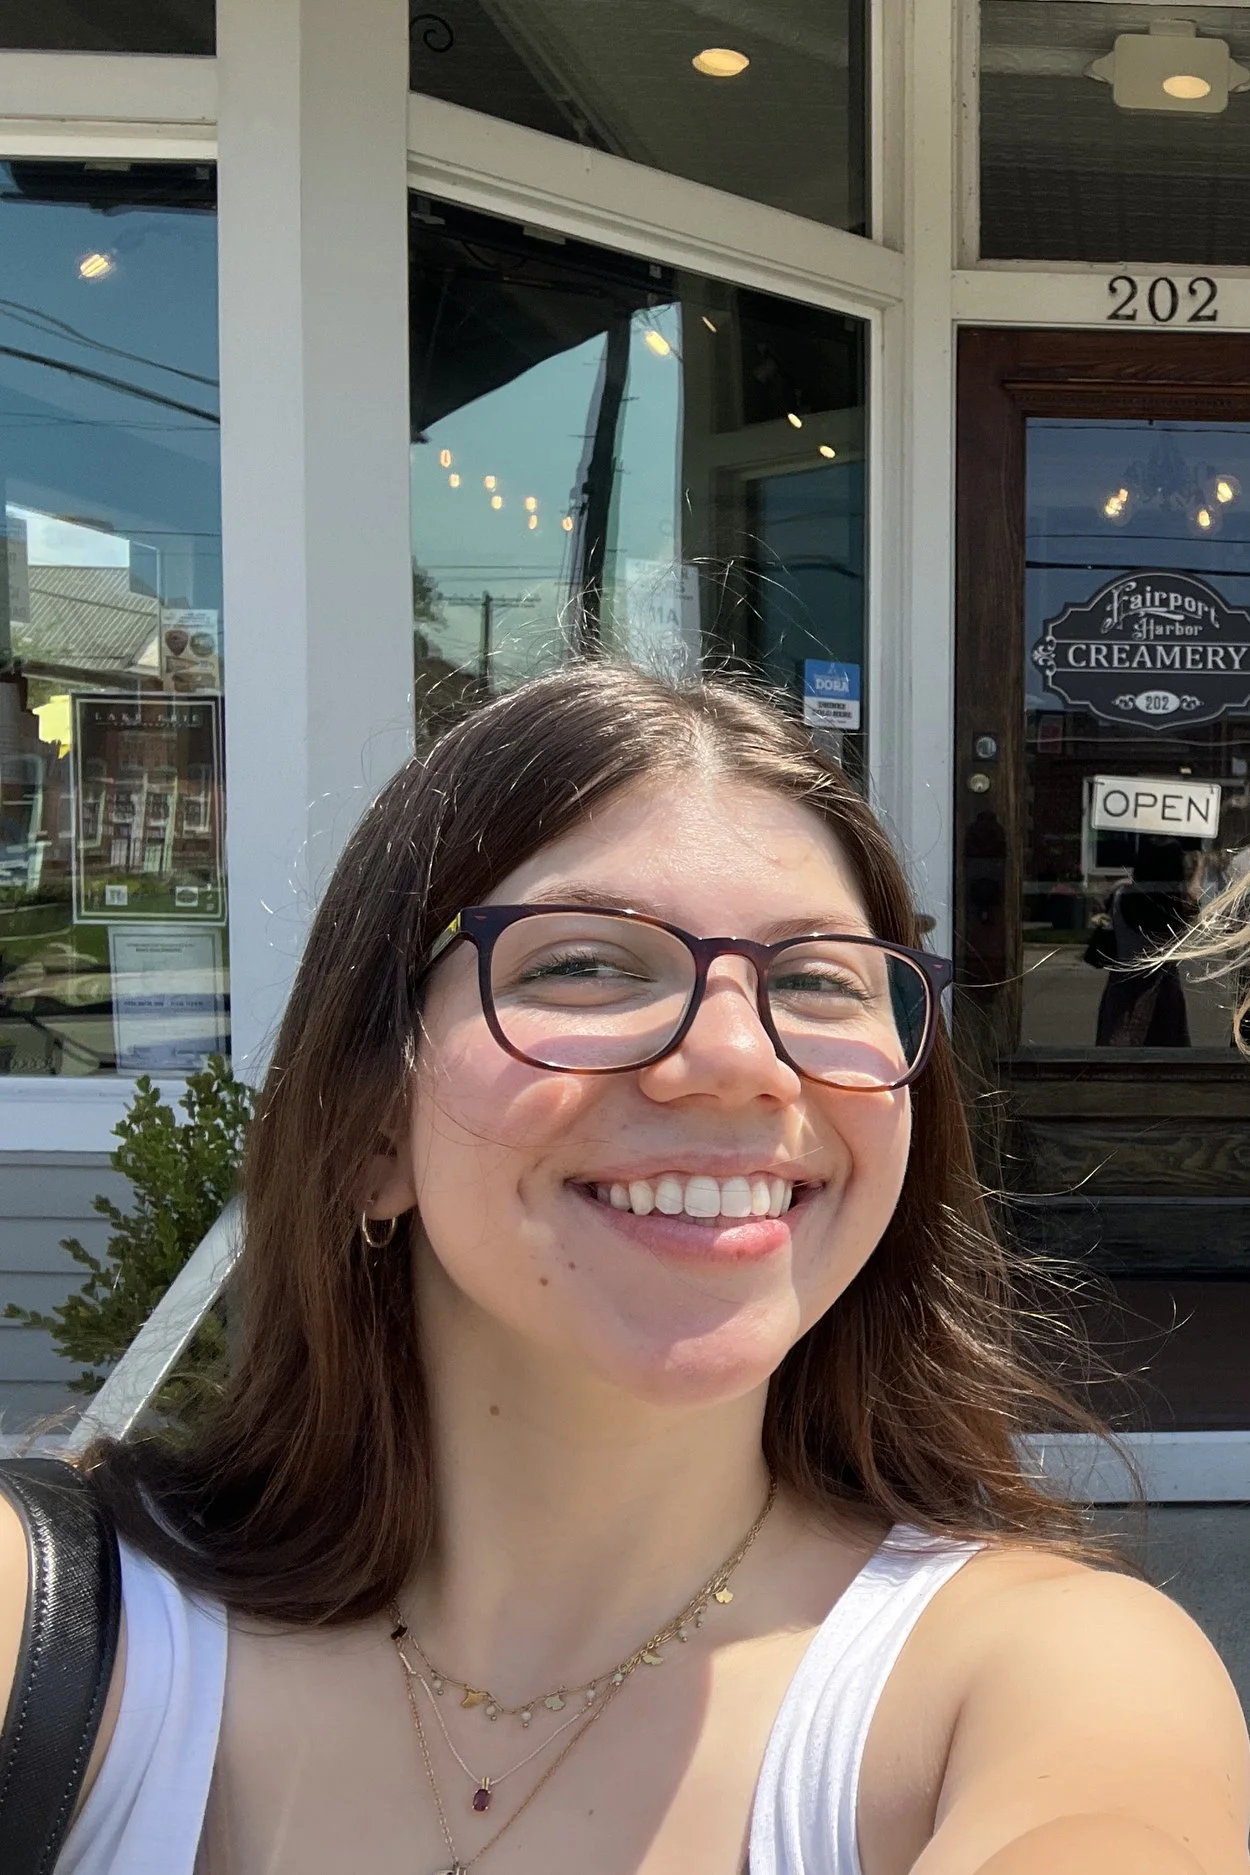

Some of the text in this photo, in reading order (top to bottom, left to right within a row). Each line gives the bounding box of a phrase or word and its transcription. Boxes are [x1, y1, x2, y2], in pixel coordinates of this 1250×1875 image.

[1106, 275, 1218, 322] 202
[1101, 581, 1220, 634] Fairport
[1132, 610, 1203, 641] Harbor
[1067, 643, 1248, 670] CREAMERY
[1145, 695, 1170, 710] 202
[1103, 790, 1209, 823] OPEN
